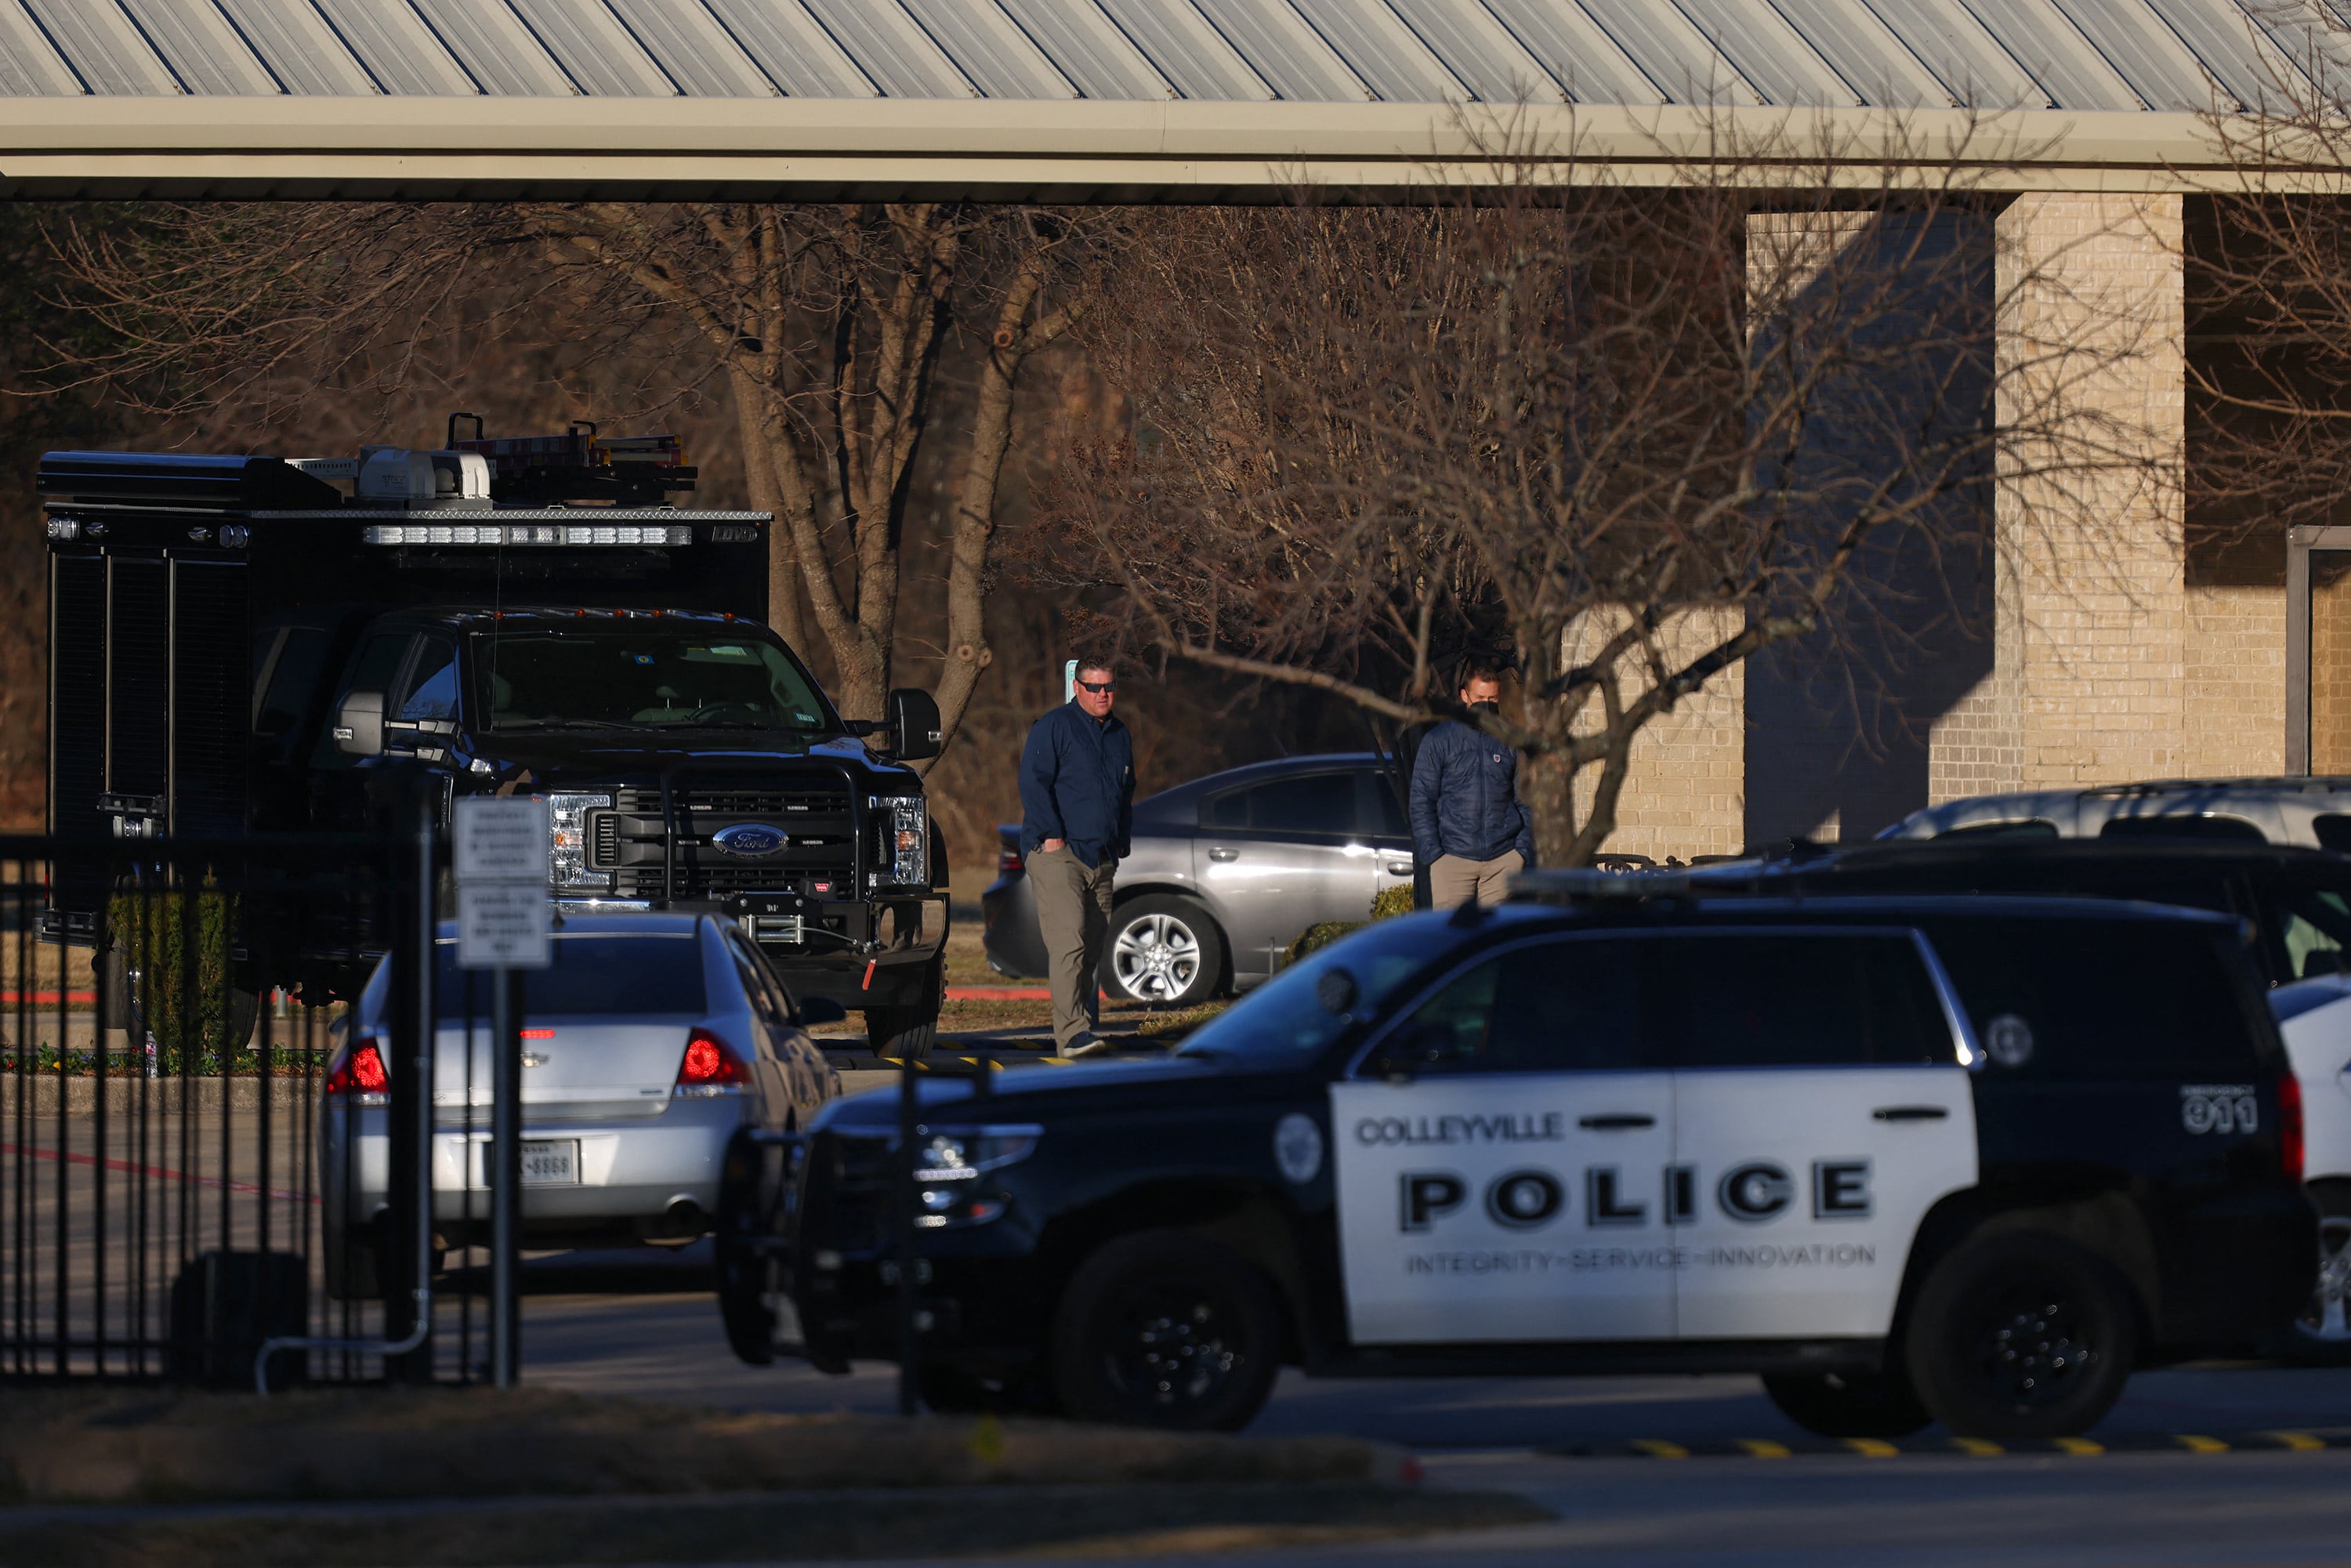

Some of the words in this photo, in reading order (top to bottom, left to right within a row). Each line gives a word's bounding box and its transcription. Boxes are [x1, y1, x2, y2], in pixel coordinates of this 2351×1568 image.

[734, 832, 770, 849] Ford
[1355, 1112, 1564, 1146] COLLEYVILLE
[2182, 1095, 2258, 1135] 911
[1400, 1160, 1873, 1233] POLICE
